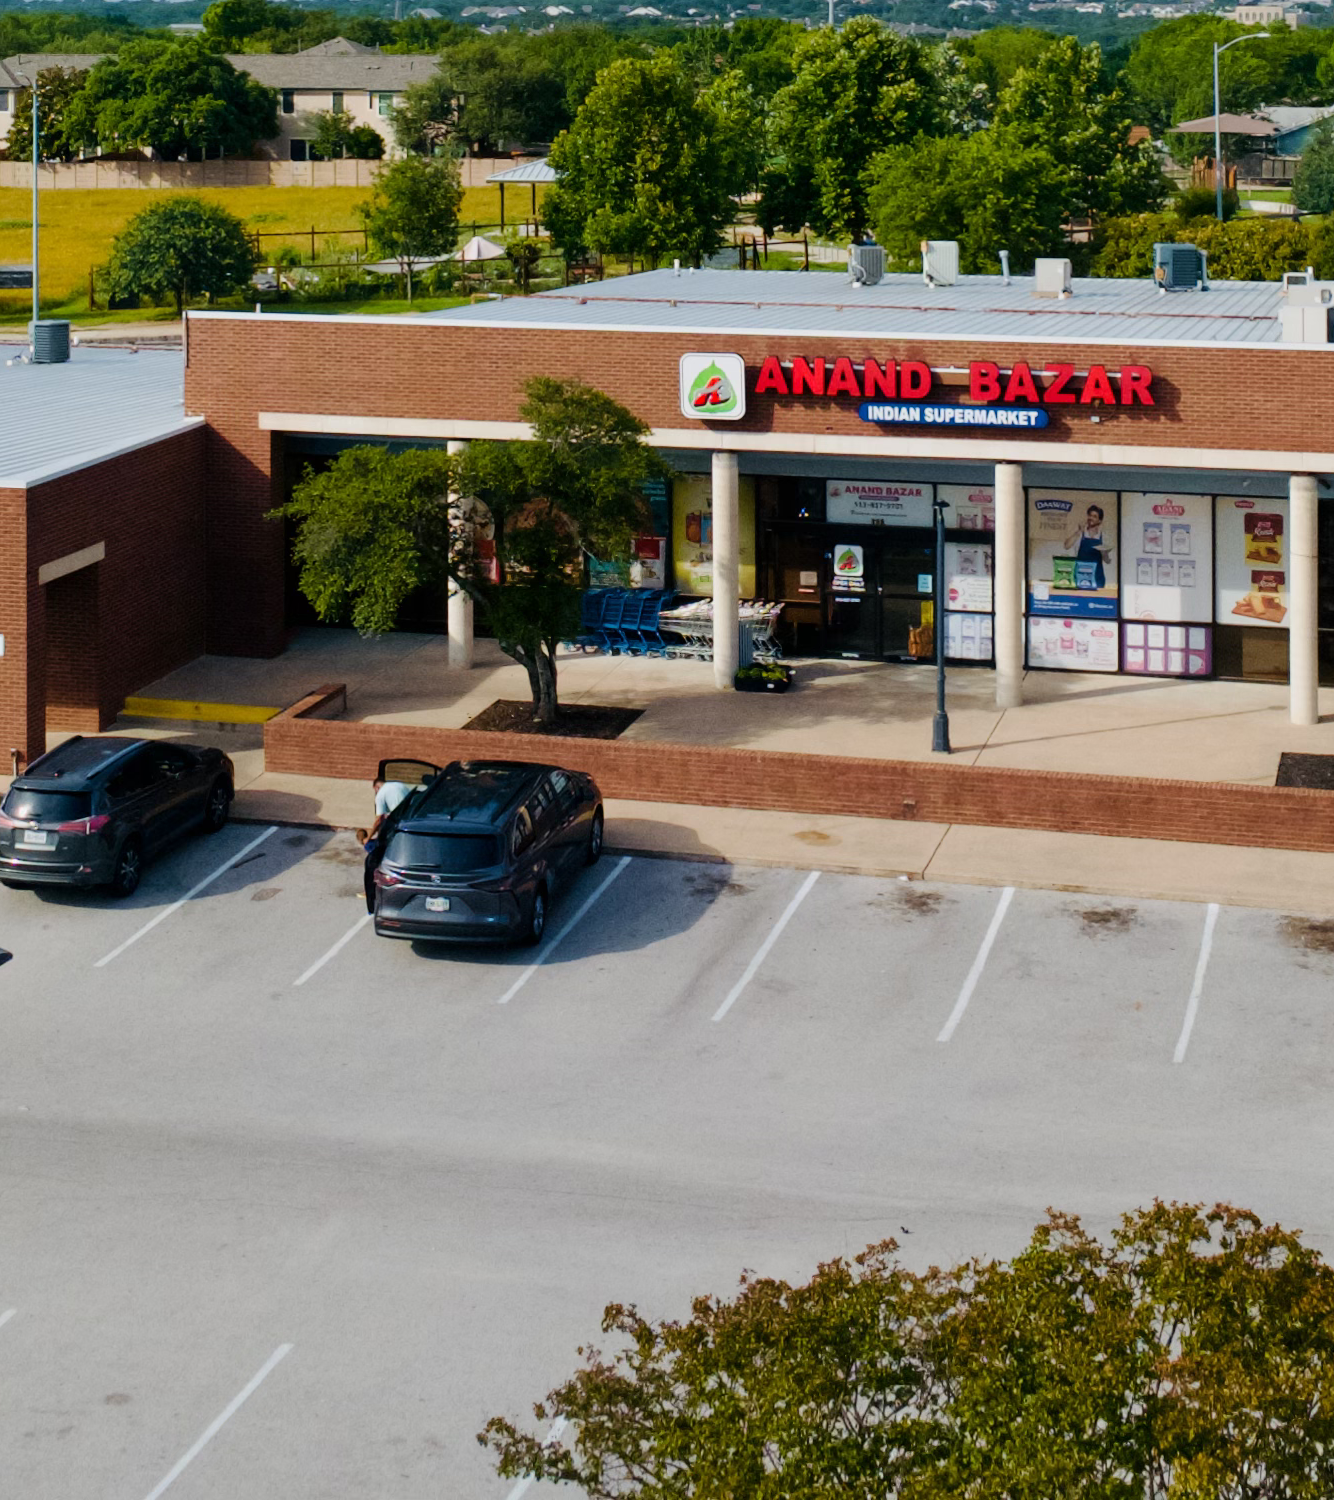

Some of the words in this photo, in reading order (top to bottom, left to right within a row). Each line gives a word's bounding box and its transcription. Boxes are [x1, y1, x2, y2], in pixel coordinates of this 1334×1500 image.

[754, 355, 932, 399] ANAND
[969, 360, 1156, 406] BAZAR
[867, 405, 921, 423] INDIAN
[923, 407, 1039, 426] SUPERMARKET
[845, 485, 883, 495] ANAND
[886, 487, 923, 497] BAZAR
